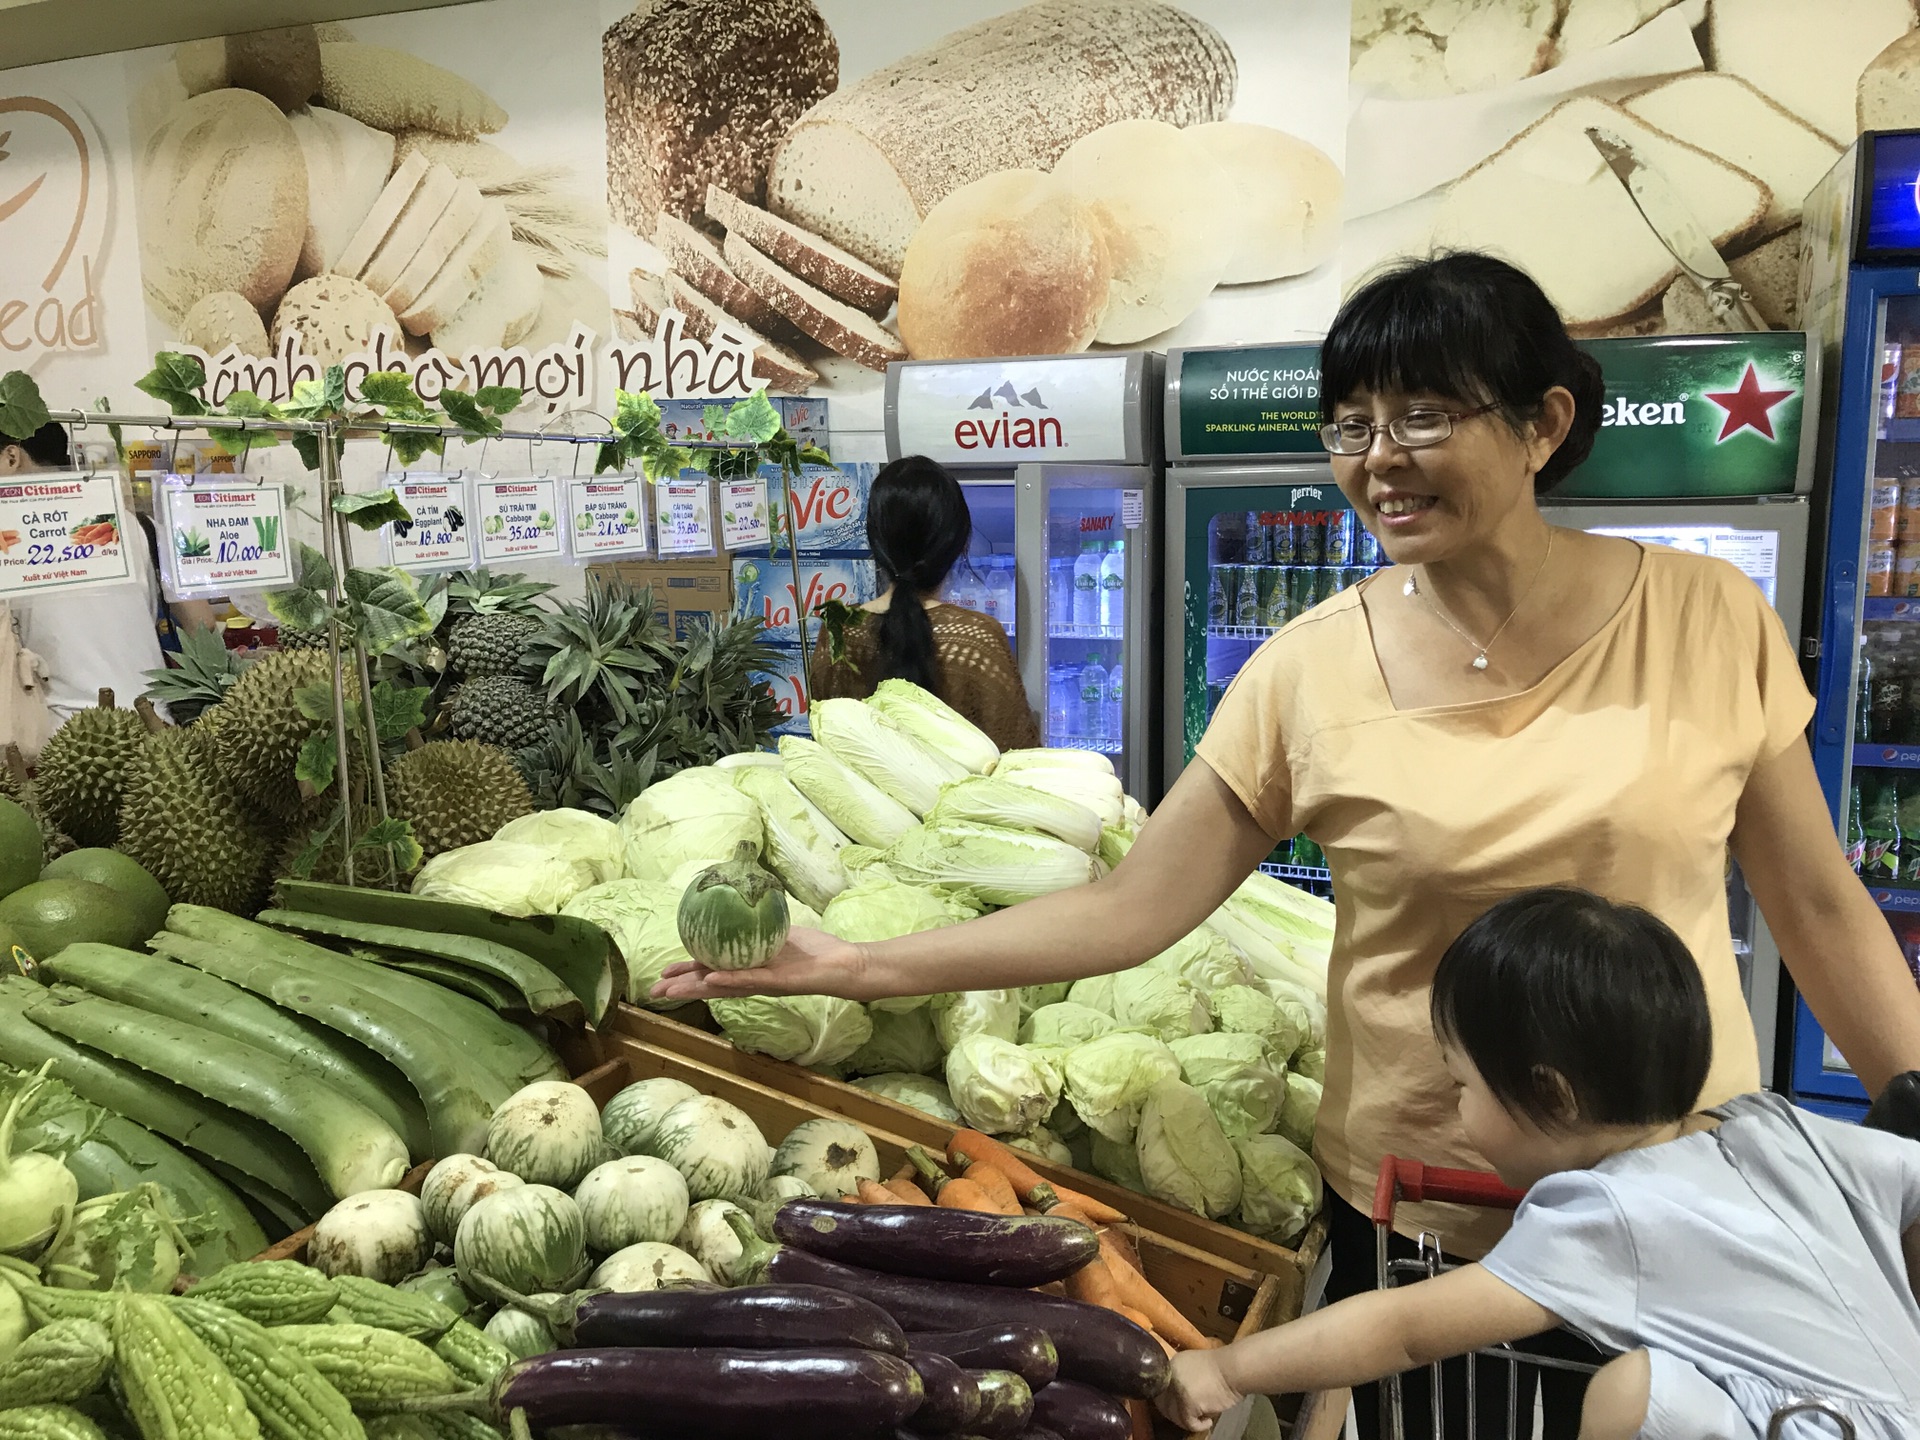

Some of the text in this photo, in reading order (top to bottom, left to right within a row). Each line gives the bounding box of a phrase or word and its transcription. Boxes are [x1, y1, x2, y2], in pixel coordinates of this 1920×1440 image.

[611, 318, 753, 398] nhà
[1226, 367, 1270, 382] NƯỚC
[1210, 383, 1321, 400] SỐ 1 THẾ GIỚI Đ
[1261, 411, 1279, 420] THE
[954, 411, 1063, 450] evian
[1205, 423, 1256, 432] SPARKLING
[1257, 423, 1300, 432] MINERAL
[128, 449, 162, 459] SAPPORO
[210, 455, 237, 463] SAPPORO
[24, 483, 83, 497] Citimart
[417, 486, 447, 494] Citimart
[507, 485, 537, 493] Citimart
[212, 493, 256, 502] Citimart
[416, 504, 439, 516] CÀ TÍM
[509, 502, 525, 512] TRÁI
[525, 503, 537, 511] TIM
[22, 510, 69, 525] CÀ RỐT
[505, 514, 532, 523] Cabbage
[594, 512, 619, 520] Cabbage
[1258, 511, 1345, 526] SANAKY
[206, 517, 249, 528] NHA ĐAM
[415, 517, 442, 528] Eggplant
[1080, 513, 1116, 532] SANAKY
[29, 527, 67, 539] Carrot
[219, 531, 240, 540] Aloe
[53, 570, 69, 579] Việt
[71, 569, 88, 577] Nam
